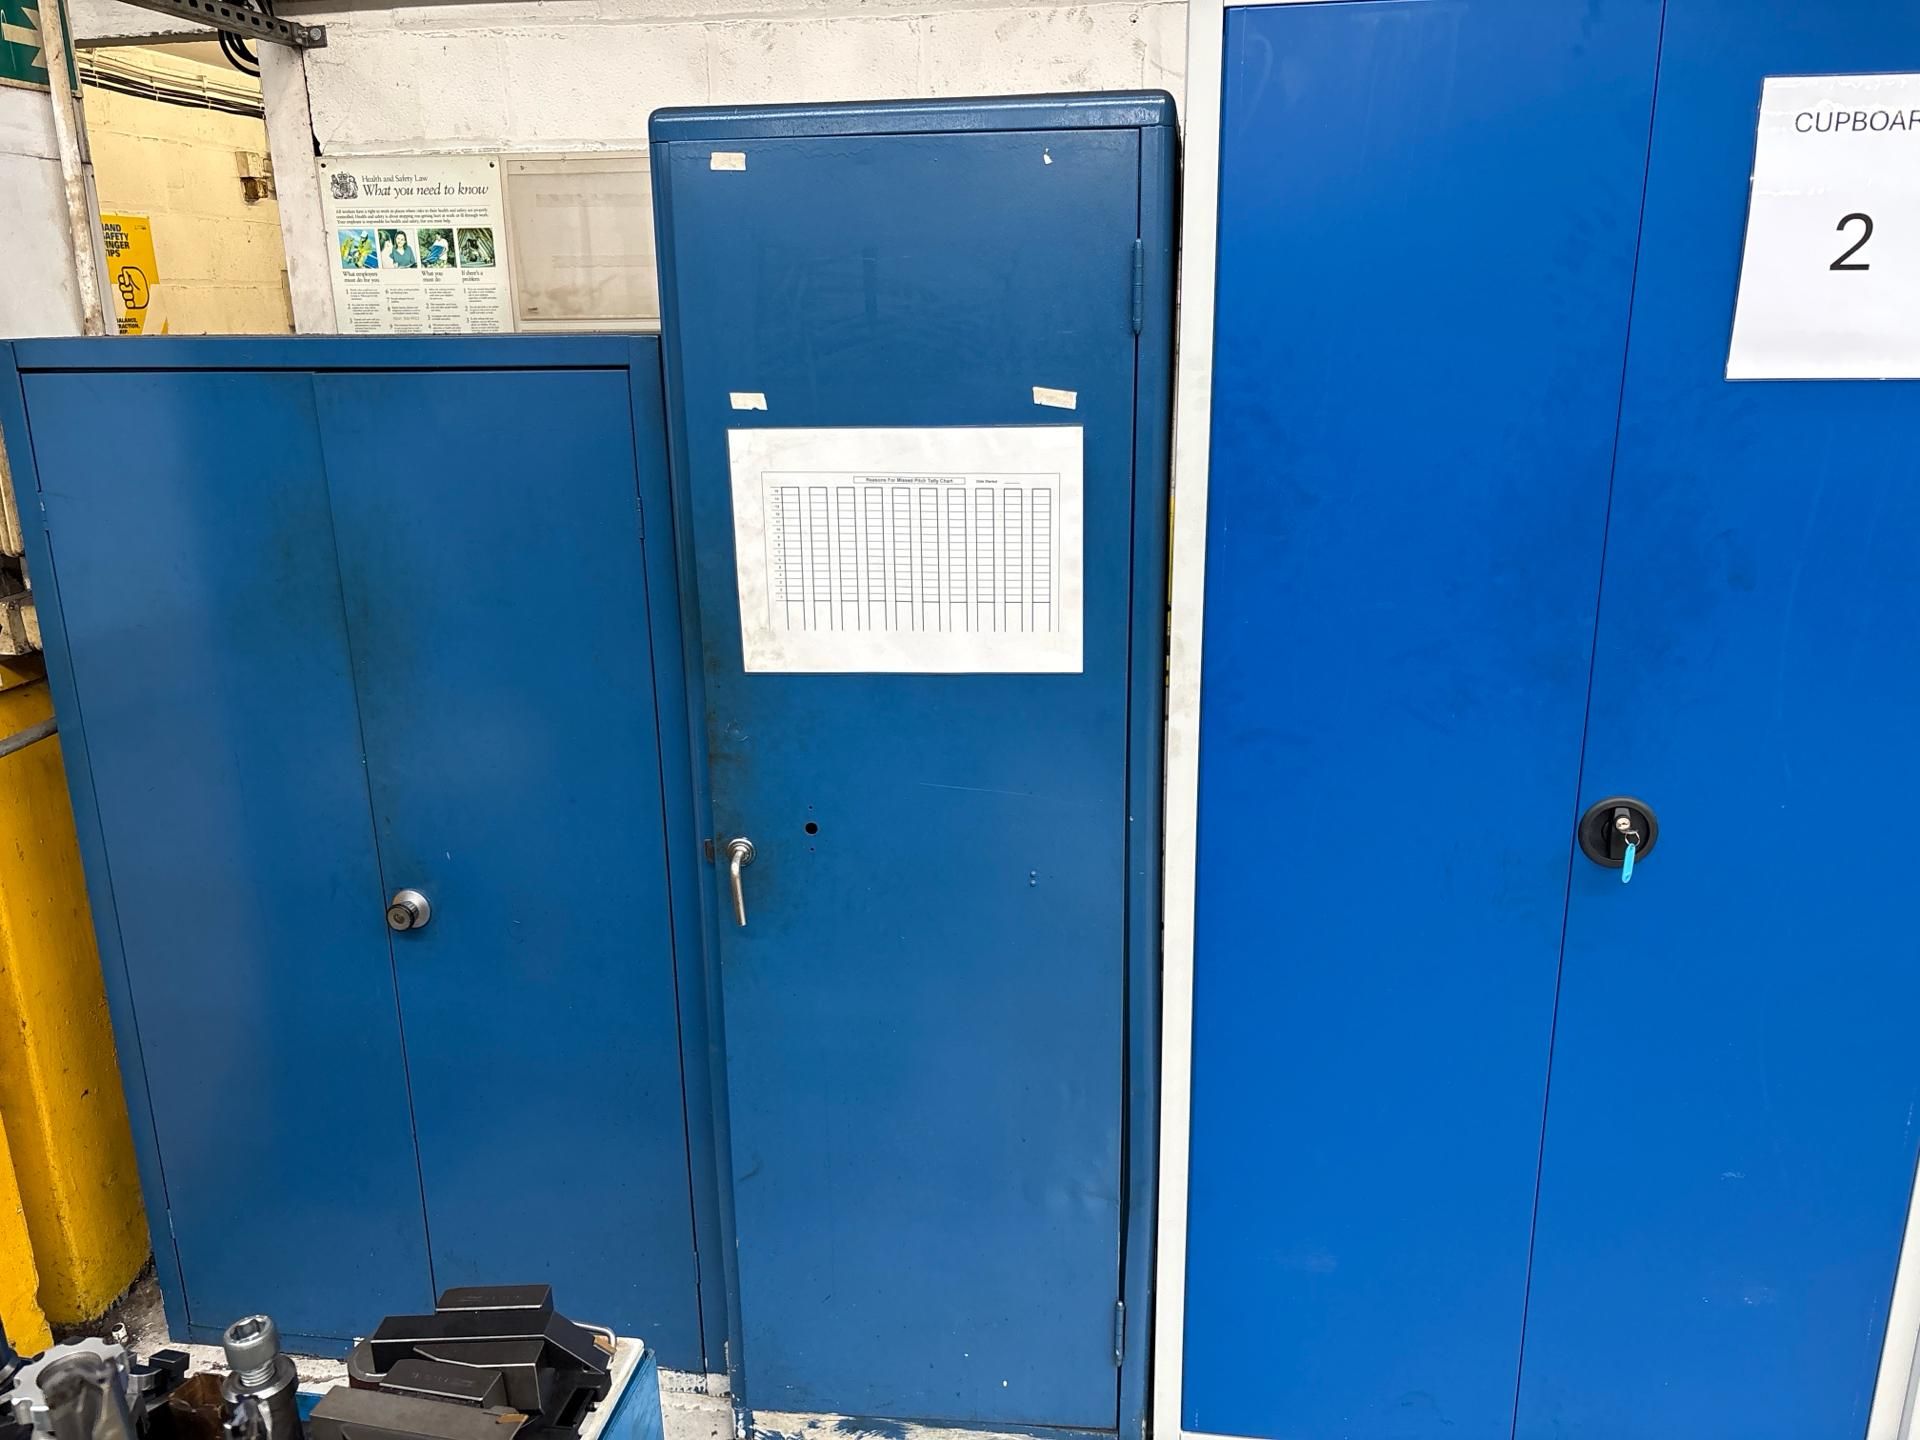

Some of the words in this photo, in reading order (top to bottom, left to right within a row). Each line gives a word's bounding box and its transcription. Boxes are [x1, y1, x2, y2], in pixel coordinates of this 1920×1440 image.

[394, 174, 412, 183] Safety
[414, 174, 428, 182] Law
[363, 183, 391, 196] What
[394, 187, 414, 199] you
[416, 182, 441, 195] need
[444, 184, 455, 195] to
[458, 181, 488, 195] know
[104, 232, 128, 240] AFETY
[105, 241, 130, 249] INGER
[1829, 212, 1874, 271] 2
